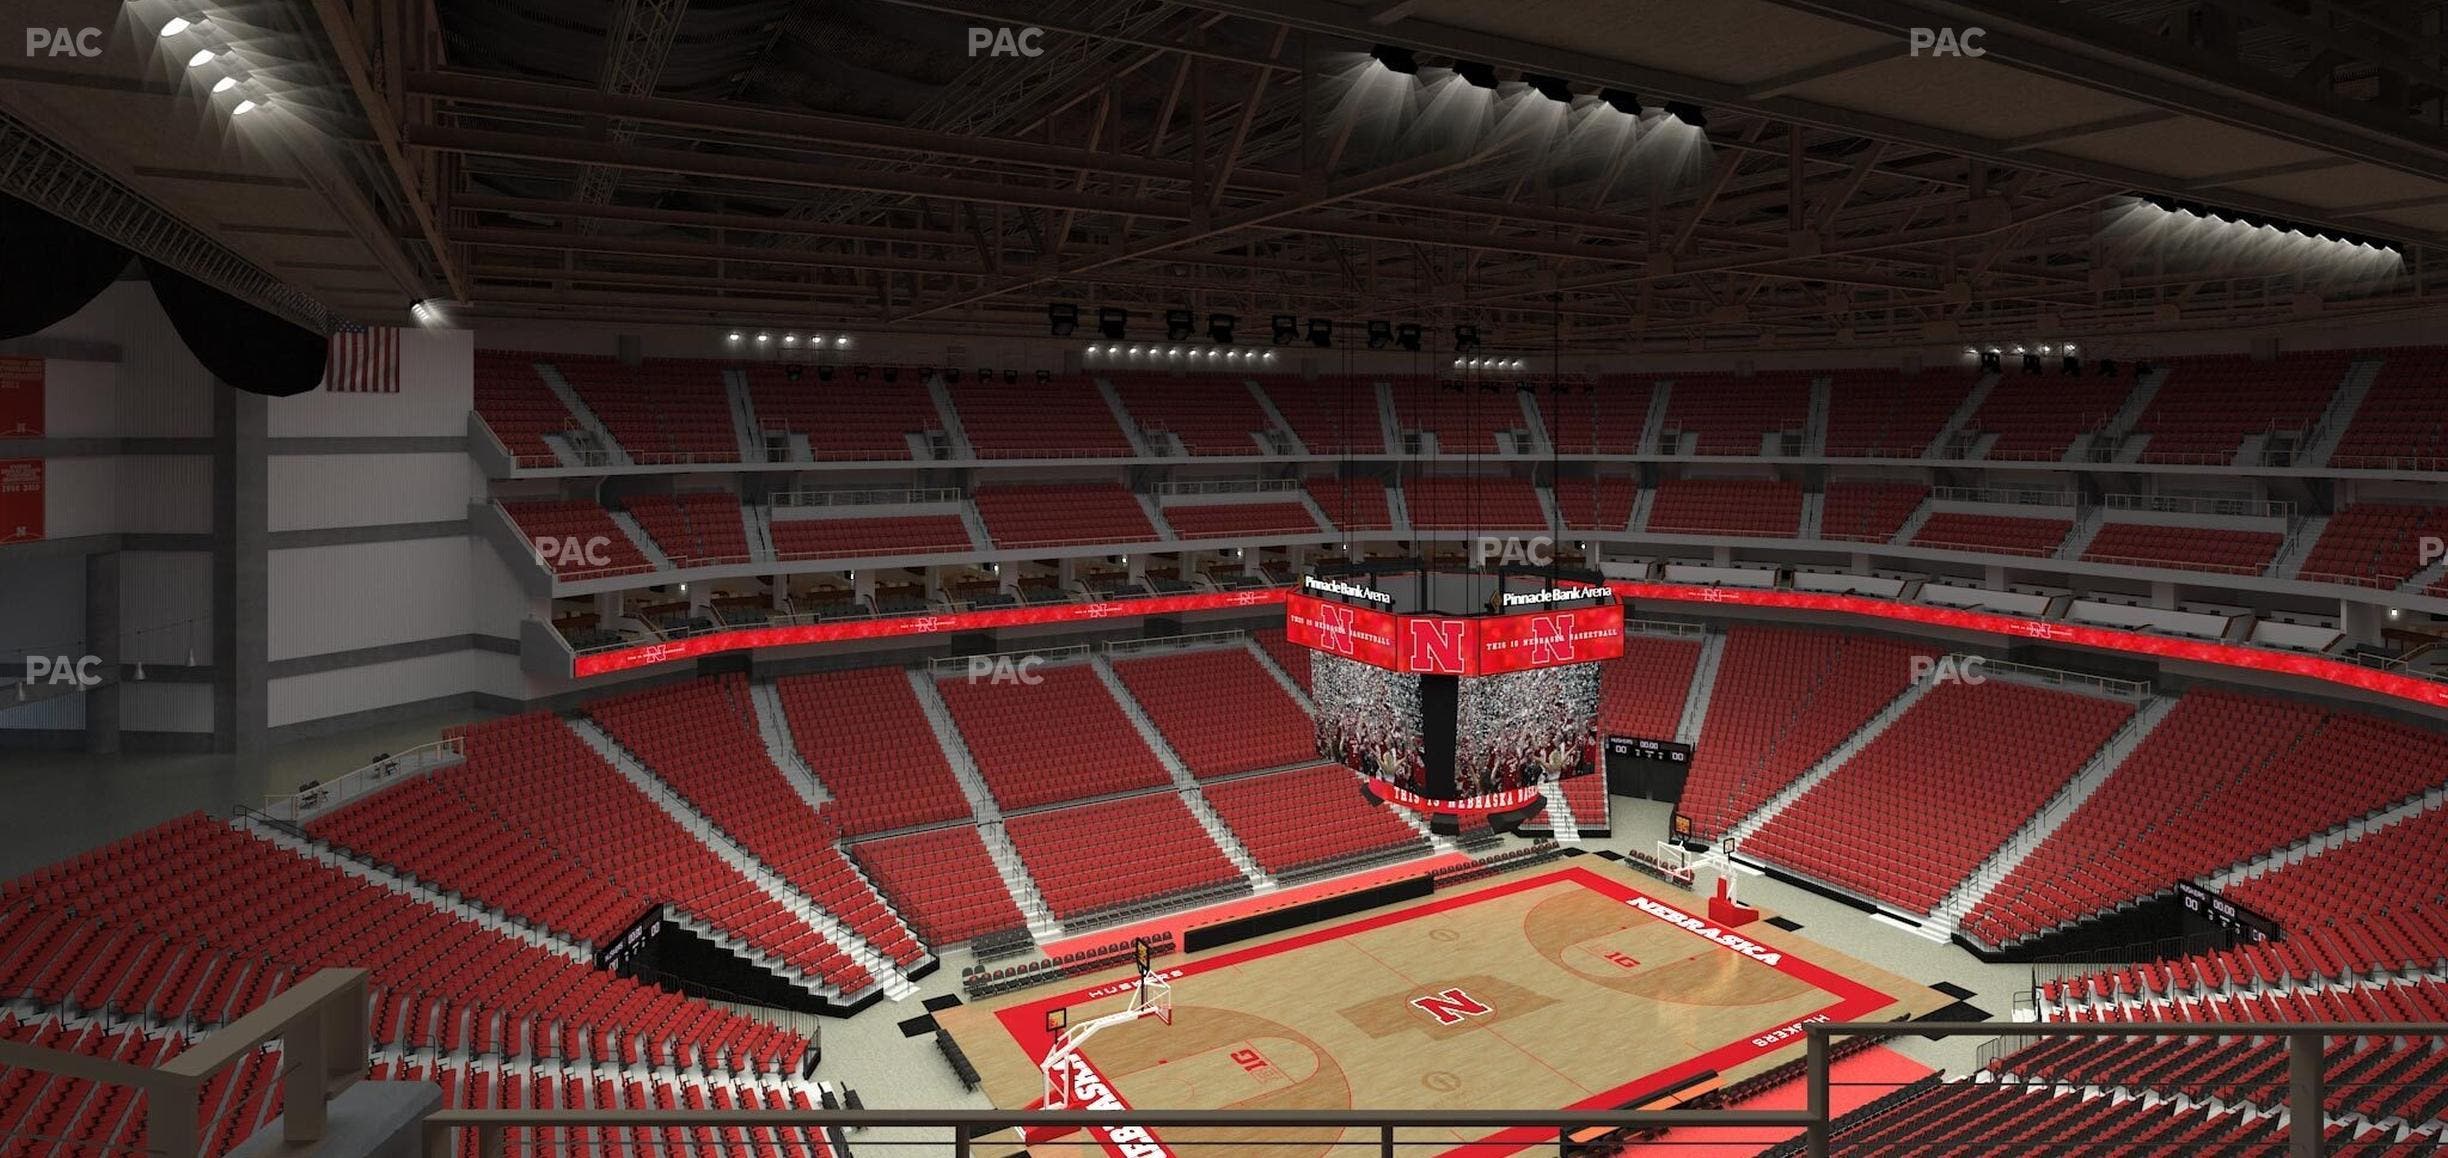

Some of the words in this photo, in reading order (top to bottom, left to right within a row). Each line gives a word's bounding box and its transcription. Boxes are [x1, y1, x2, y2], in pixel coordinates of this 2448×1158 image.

[1305, 576, 1342, 594] Pinnacle
[1341, 582, 1365, 598] Bank
[1364, 587, 1390, 604] Arena
[1503, 589, 1551, 606] Pinnacle
[1552, 586, 1582, 601] Bank
[1581, 585, 1611, 598] Arena
[1321, 604, 1353, 655] N
[1531, 614, 1574, 664] N
[1411, 619, 1465, 672] N
[1486, 642, 1507, 651] THIS
[1615, 745, 1627, 753] 00
[1672, 752, 1684, 760] 00
[2185, 896, 2198, 911] 00
[1626, 896, 1783, 966] NEBRASKA
[1411, 987, 1493, 1025] N
